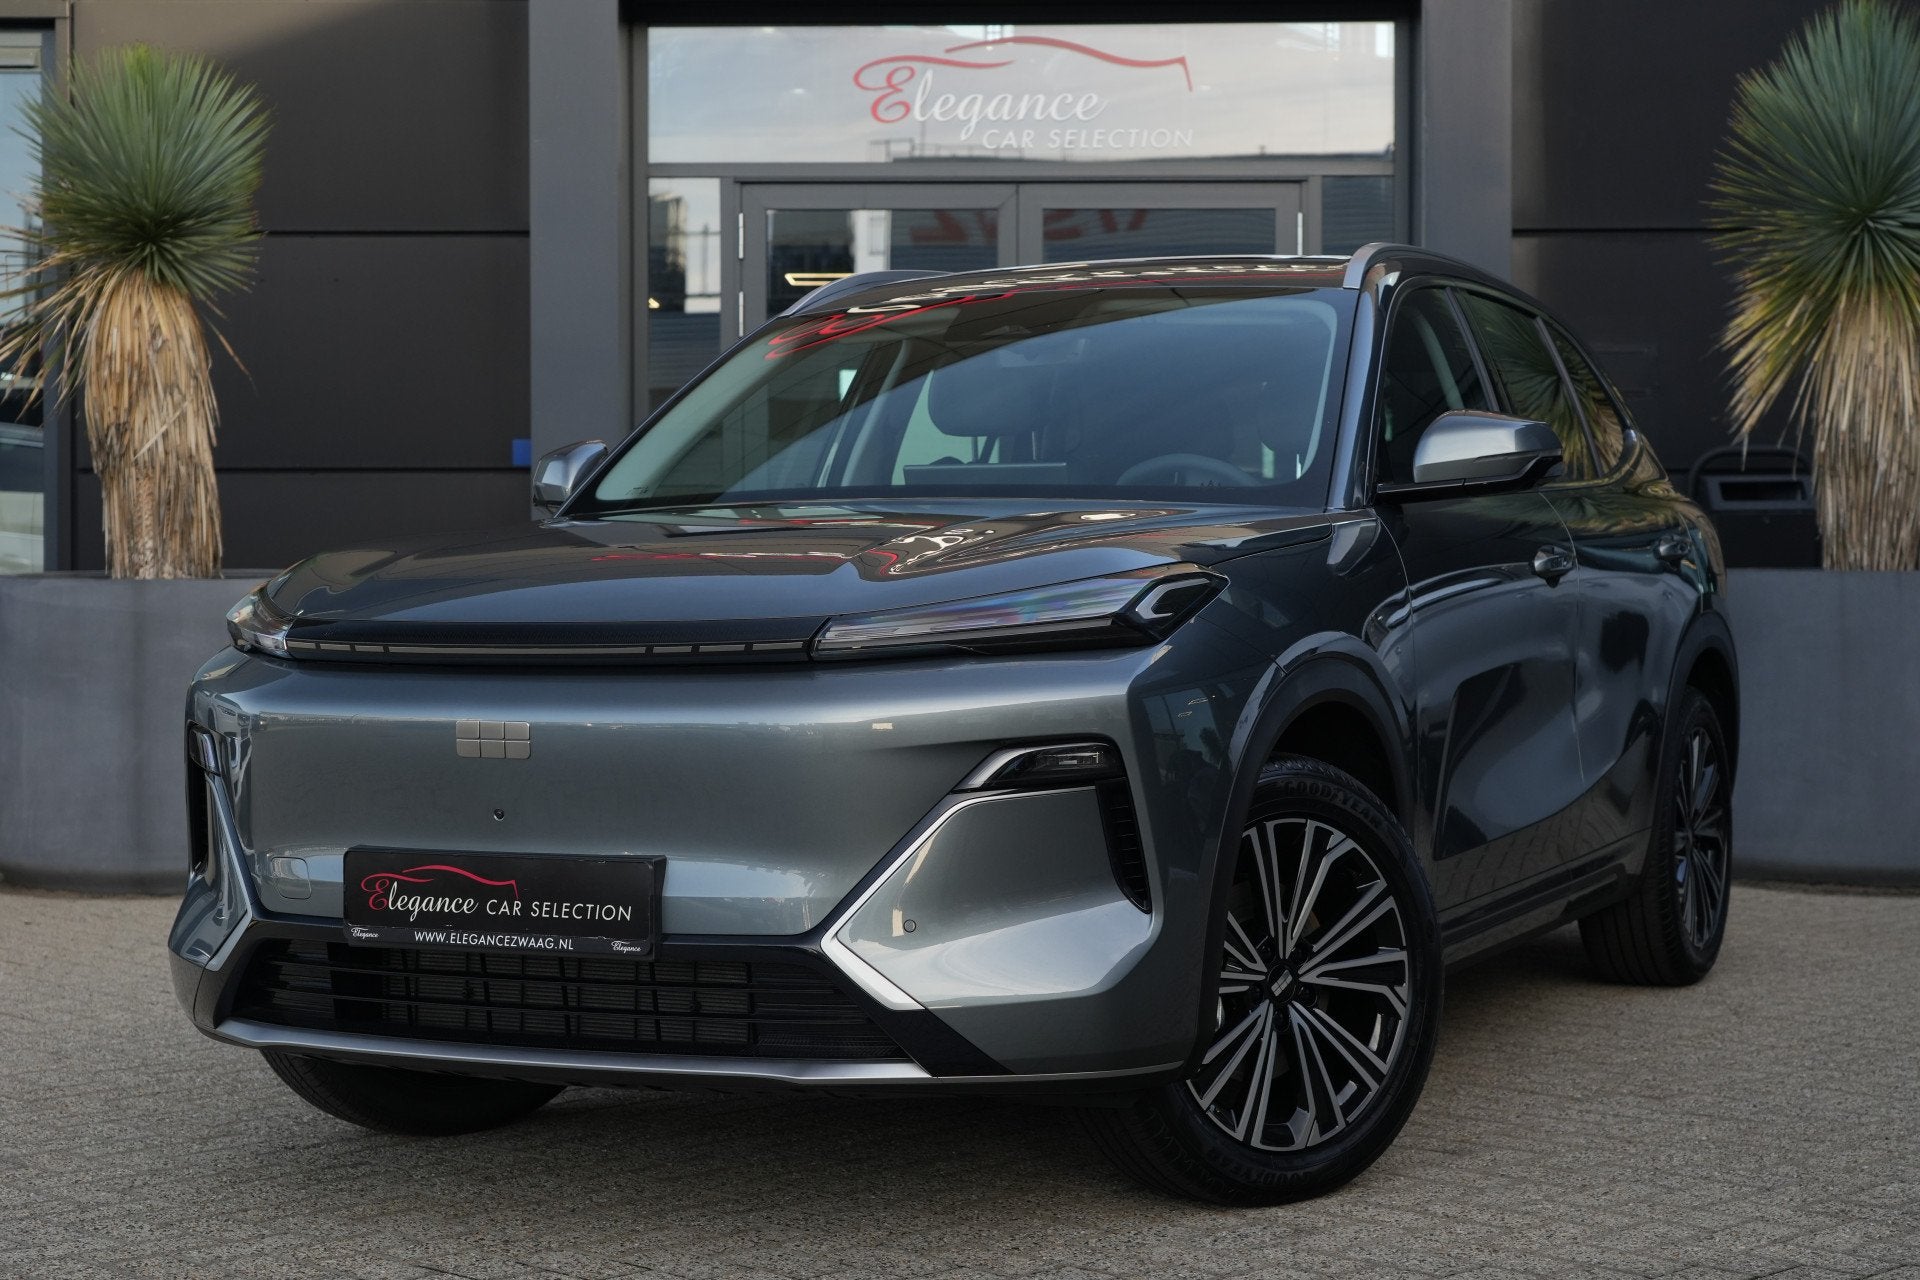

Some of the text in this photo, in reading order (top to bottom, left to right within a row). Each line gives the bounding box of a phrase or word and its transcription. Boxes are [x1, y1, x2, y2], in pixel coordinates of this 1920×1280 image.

[854, 55, 1109, 140] Elegance
[983, 128, 1194, 150] CAR SELECTION
[361, 872, 632, 921] Elegance CAR SELECTION
[414, 930, 574, 950] WWW.ELEGANCEZWAAG.NL
